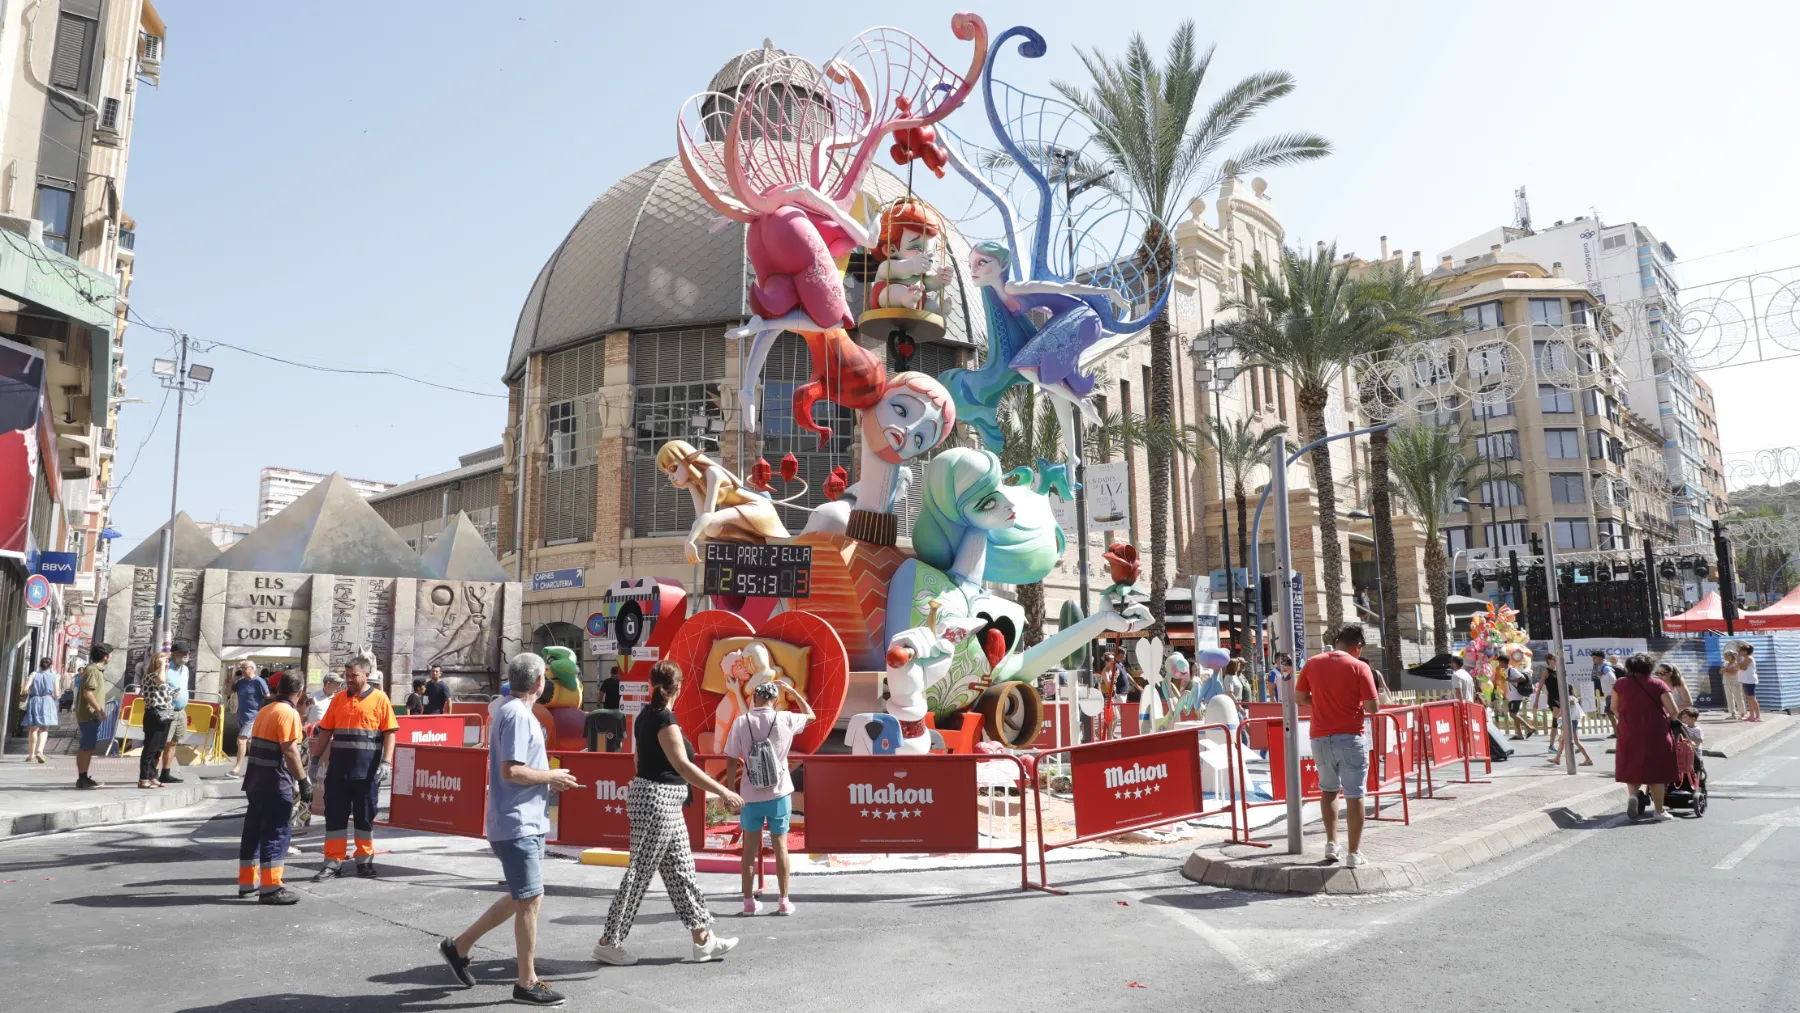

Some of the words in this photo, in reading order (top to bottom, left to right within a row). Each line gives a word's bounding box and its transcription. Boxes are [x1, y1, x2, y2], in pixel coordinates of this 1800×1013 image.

[707, 545, 733, 561] ELL
[770, 547, 778, 567] 2
[781, 547, 810, 562] ELLA
[41, 563, 72, 572] BBVA
[254, 577, 284, 590] ELS
[535, 572, 554, 581] CARNES
[737, 574, 778, 594] 95:13
[249, 594, 288, 606] VINT
[256, 611, 277, 623] EN
[627, 617, 635, 635] à
[237, 627, 293, 641] COPES
[411, 729, 448, 743] Mahou
[415, 768, 462, 791] Mahou
[1104, 762, 1168, 789] Mahou
[847, 782, 935, 805] Mahou
